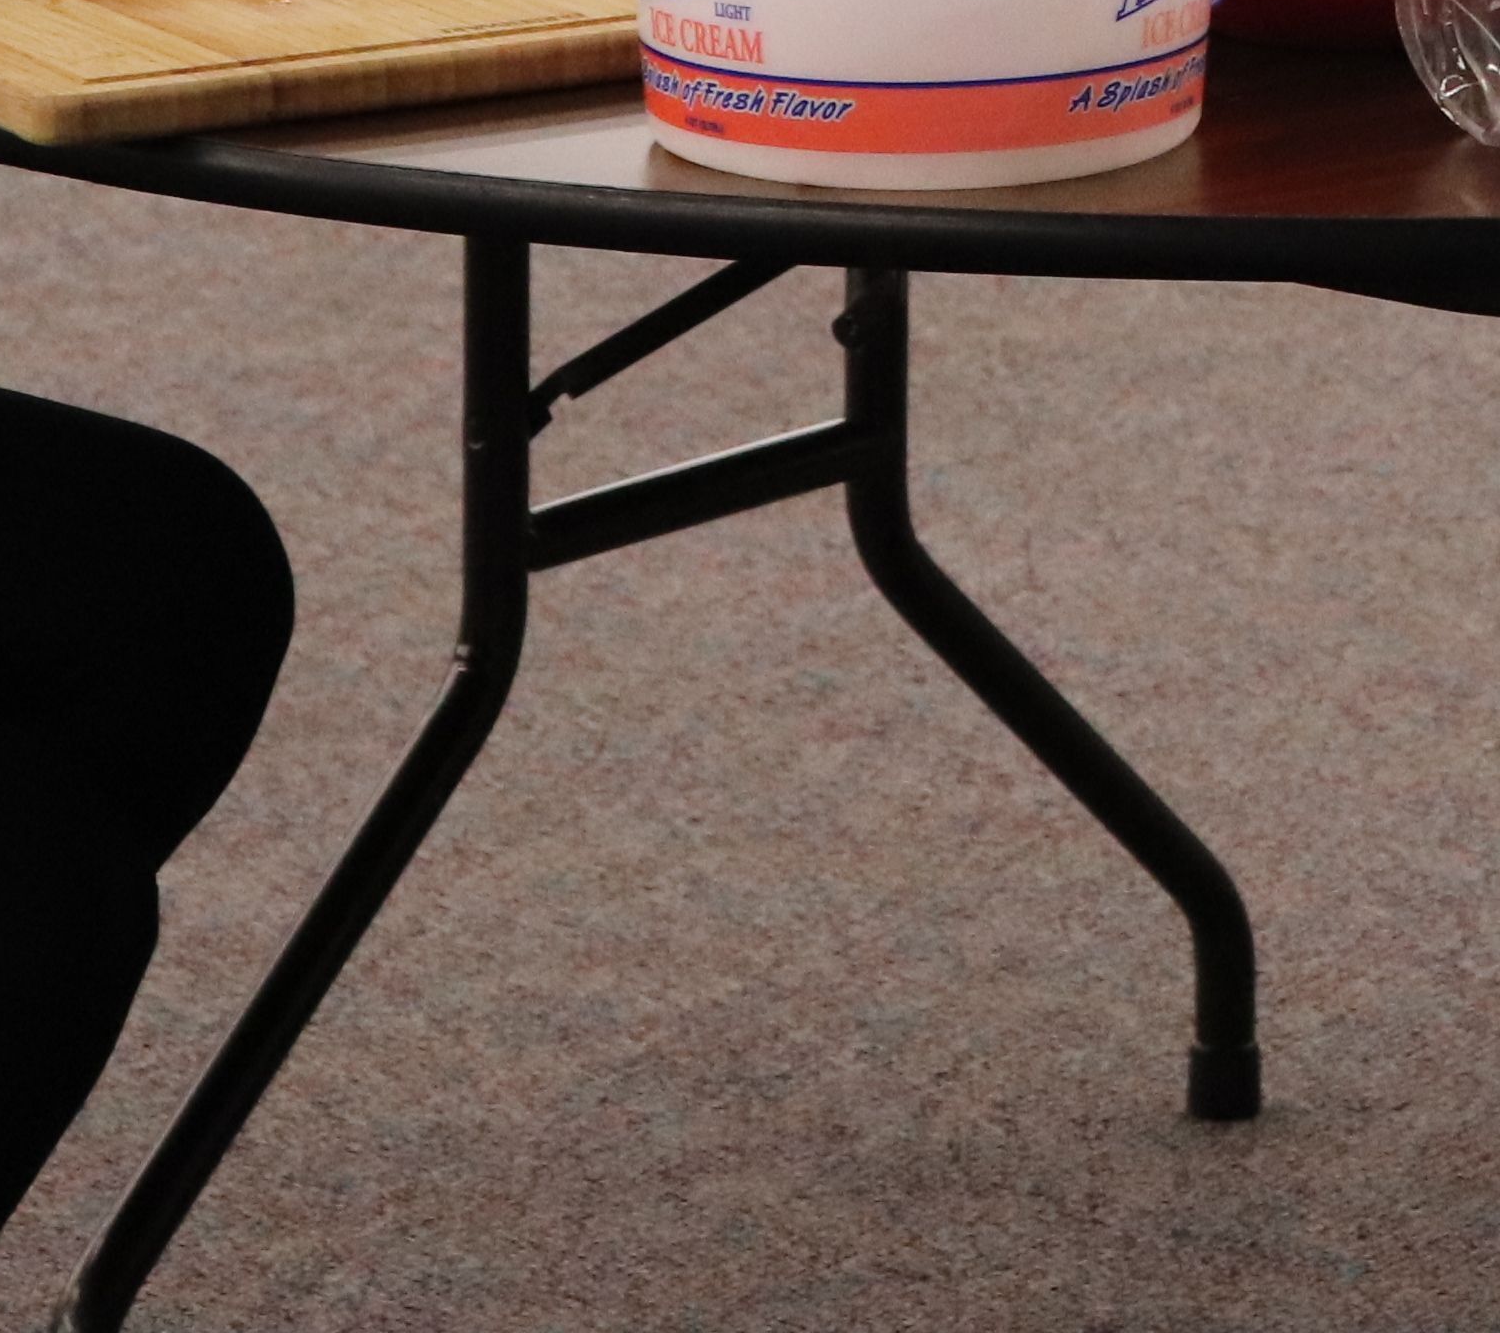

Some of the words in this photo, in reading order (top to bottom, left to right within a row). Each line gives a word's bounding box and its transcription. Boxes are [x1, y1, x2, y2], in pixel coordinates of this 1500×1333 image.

[713, 1, 751, 21] LIGHT
[650, 6, 676, 47] ICE
[679, 18, 766, 65] CREAM
[681, 80, 704, 109] of
[702, 82, 767, 114] Fresh
[769, 91, 854, 120] Flavor
[1068, 85, 1093, 113] A
[1097, 68, 1172, 113] Splash
